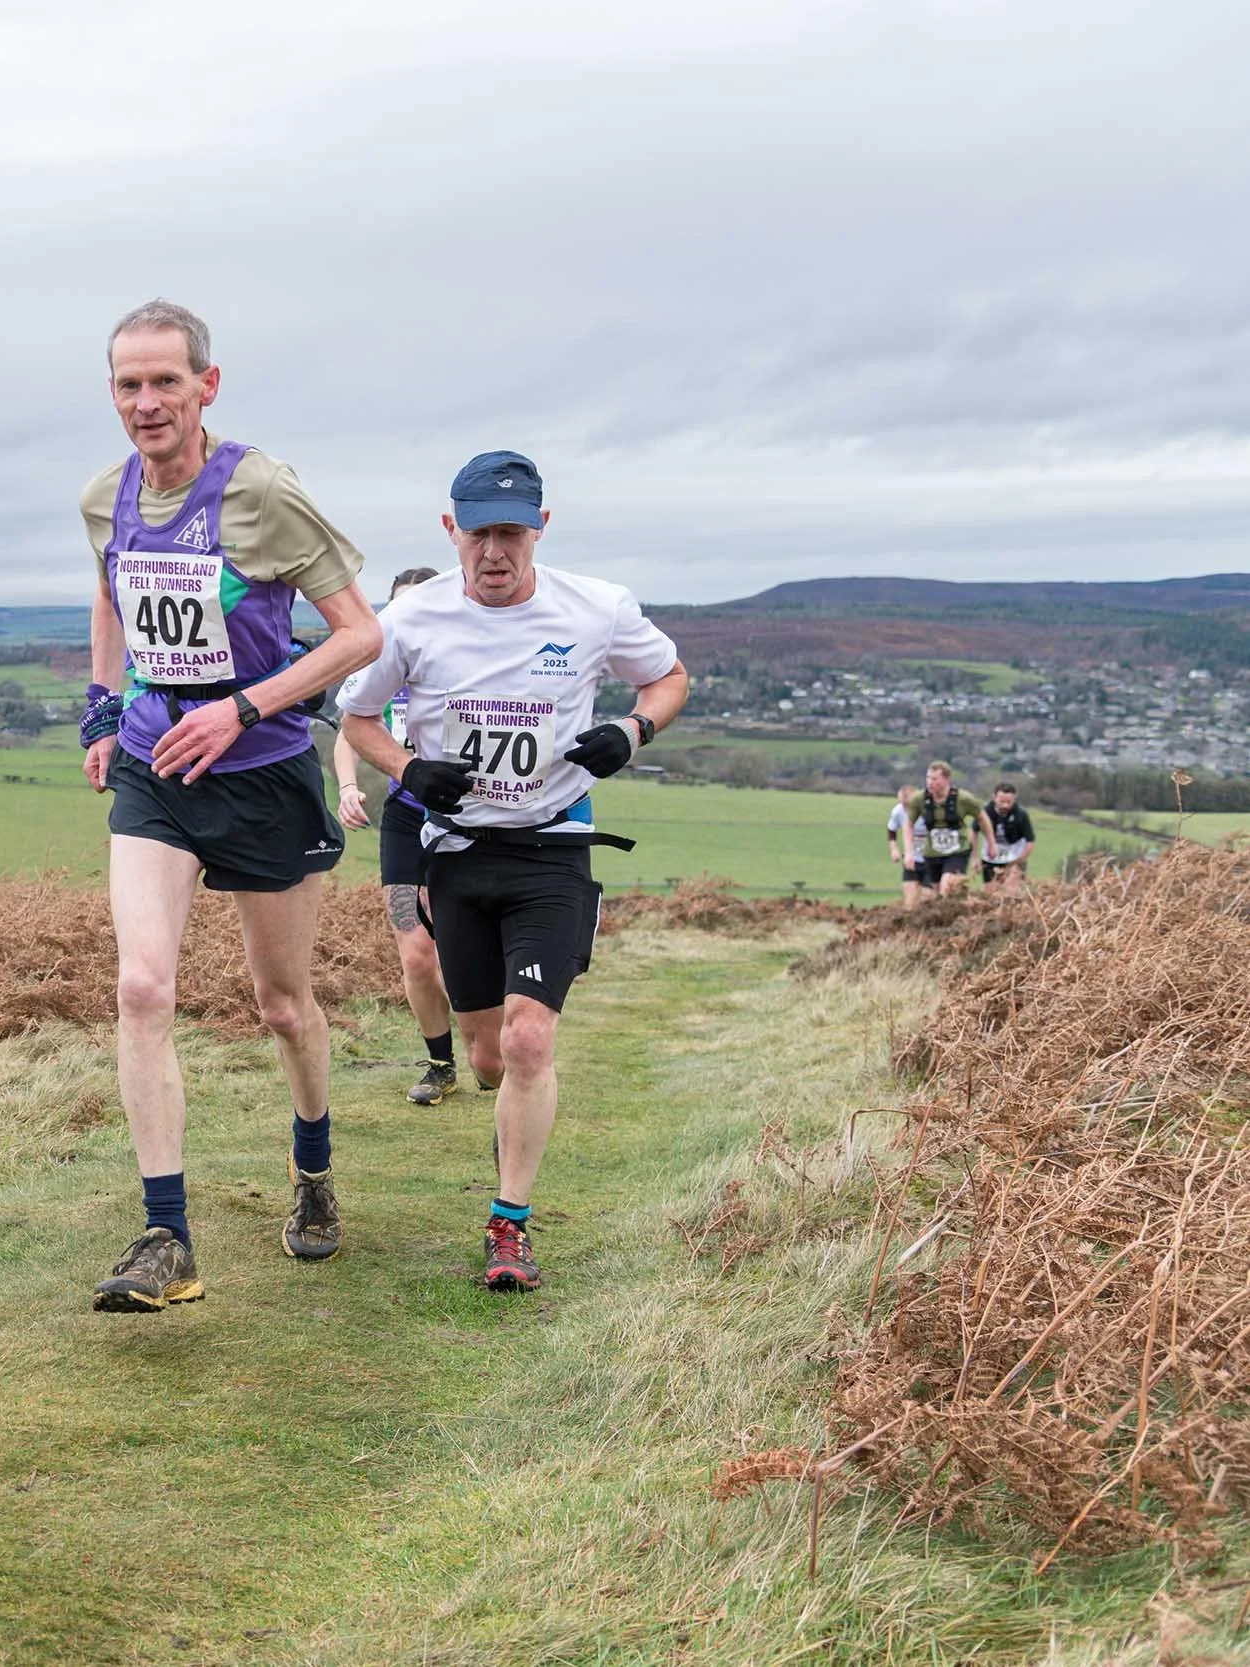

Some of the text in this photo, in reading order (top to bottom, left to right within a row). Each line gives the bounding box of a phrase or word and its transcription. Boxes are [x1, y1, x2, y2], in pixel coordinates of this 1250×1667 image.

[191, 519, 204, 533] N
[182, 530, 205, 547] FR
[119, 559, 217, 577] NORTHUMBERLAND
[130, 576, 202, 592] FELL RUNNERS
[136, 595, 209, 648] 402
[133, 649, 229, 666] PETE BLAND
[542, 659, 568, 668] 2025
[151, 666, 201, 677] SPORTS
[447, 699, 554, 714] NORTHUMBERLAND
[459, 712, 540, 727] FELL RUNNERS
[459, 729, 538, 777] 470
[492, 779, 543, 793] BLAND
